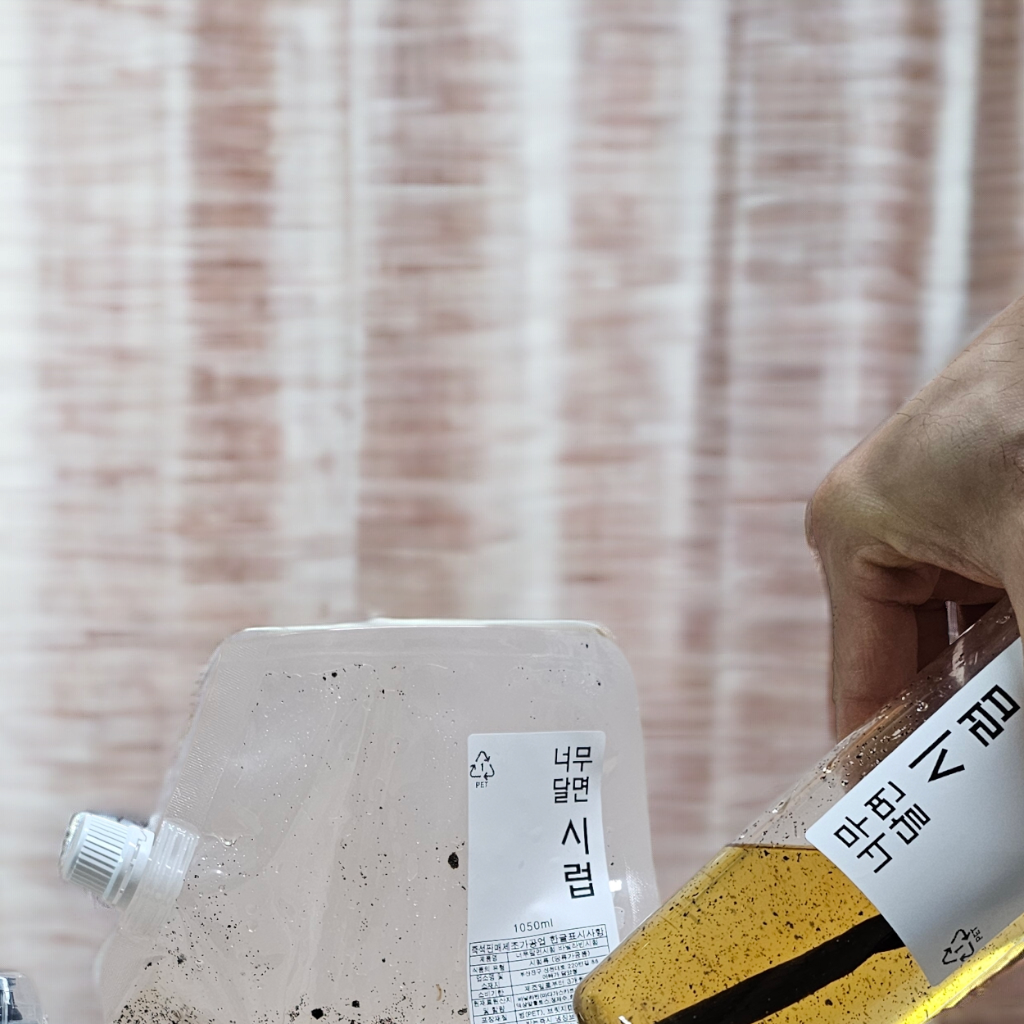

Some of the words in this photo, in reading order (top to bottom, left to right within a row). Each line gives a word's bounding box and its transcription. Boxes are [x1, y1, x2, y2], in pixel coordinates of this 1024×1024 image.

[908, 684, 1020, 783] 시럽
[554, 746, 593, 772] 너무
[553, 776, 589, 804] 달면
[864, 780, 931, 845] 달면
[561, 817, 595, 899] 시럽
[834, 816, 893, 873] 너무
[514, 918, 554, 933] 1050ml
[970, 927, 983, 942] PET
